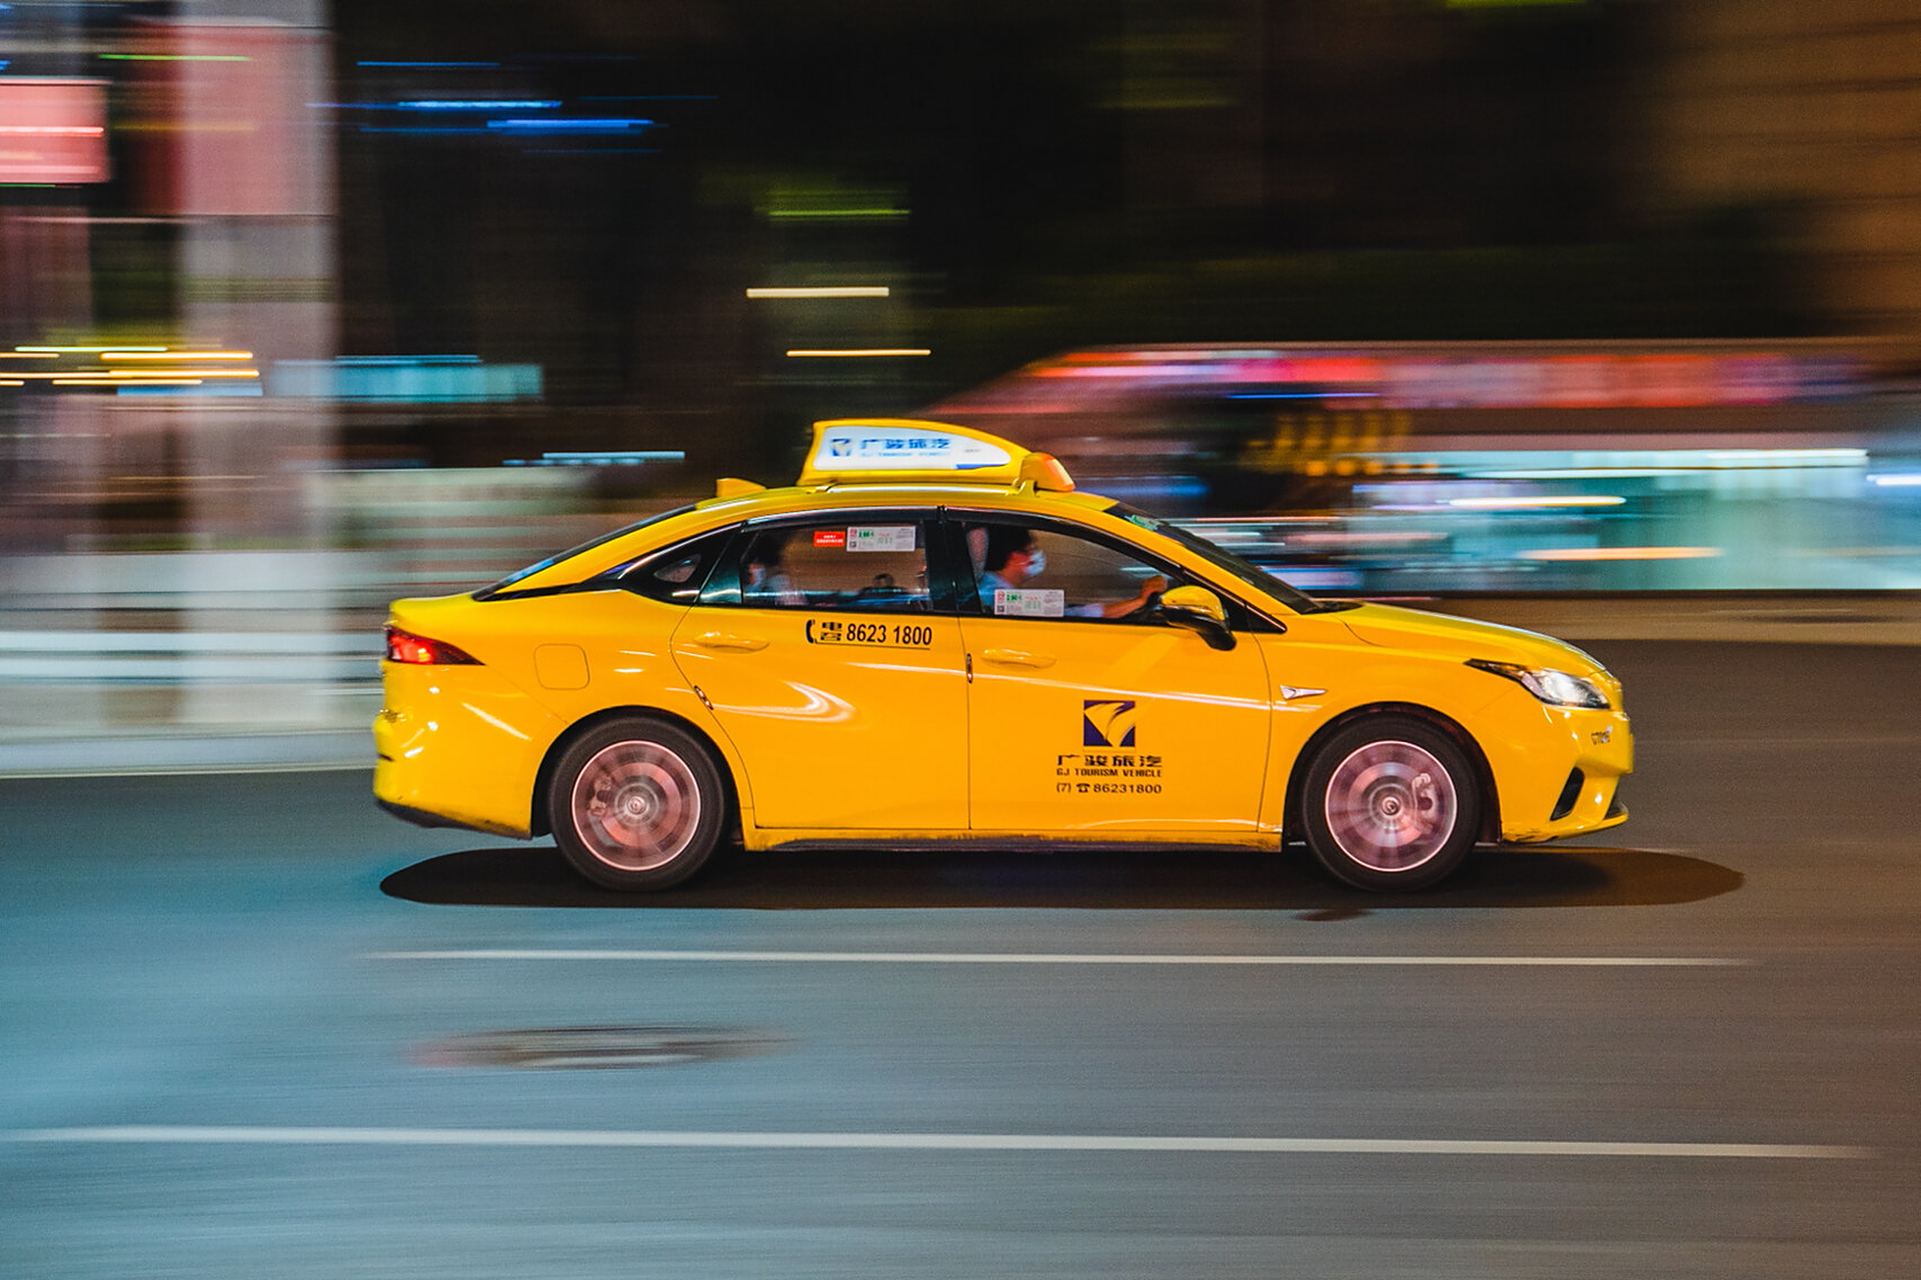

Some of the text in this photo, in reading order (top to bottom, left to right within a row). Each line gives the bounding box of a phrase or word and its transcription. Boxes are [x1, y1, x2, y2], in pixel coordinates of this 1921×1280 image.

[847, 623, 932, 645] 8623 1800
[1056, 768, 1162, 777] GJ TOURISM VEHICLE
[1056, 782, 1162, 794] (7) 86231800
